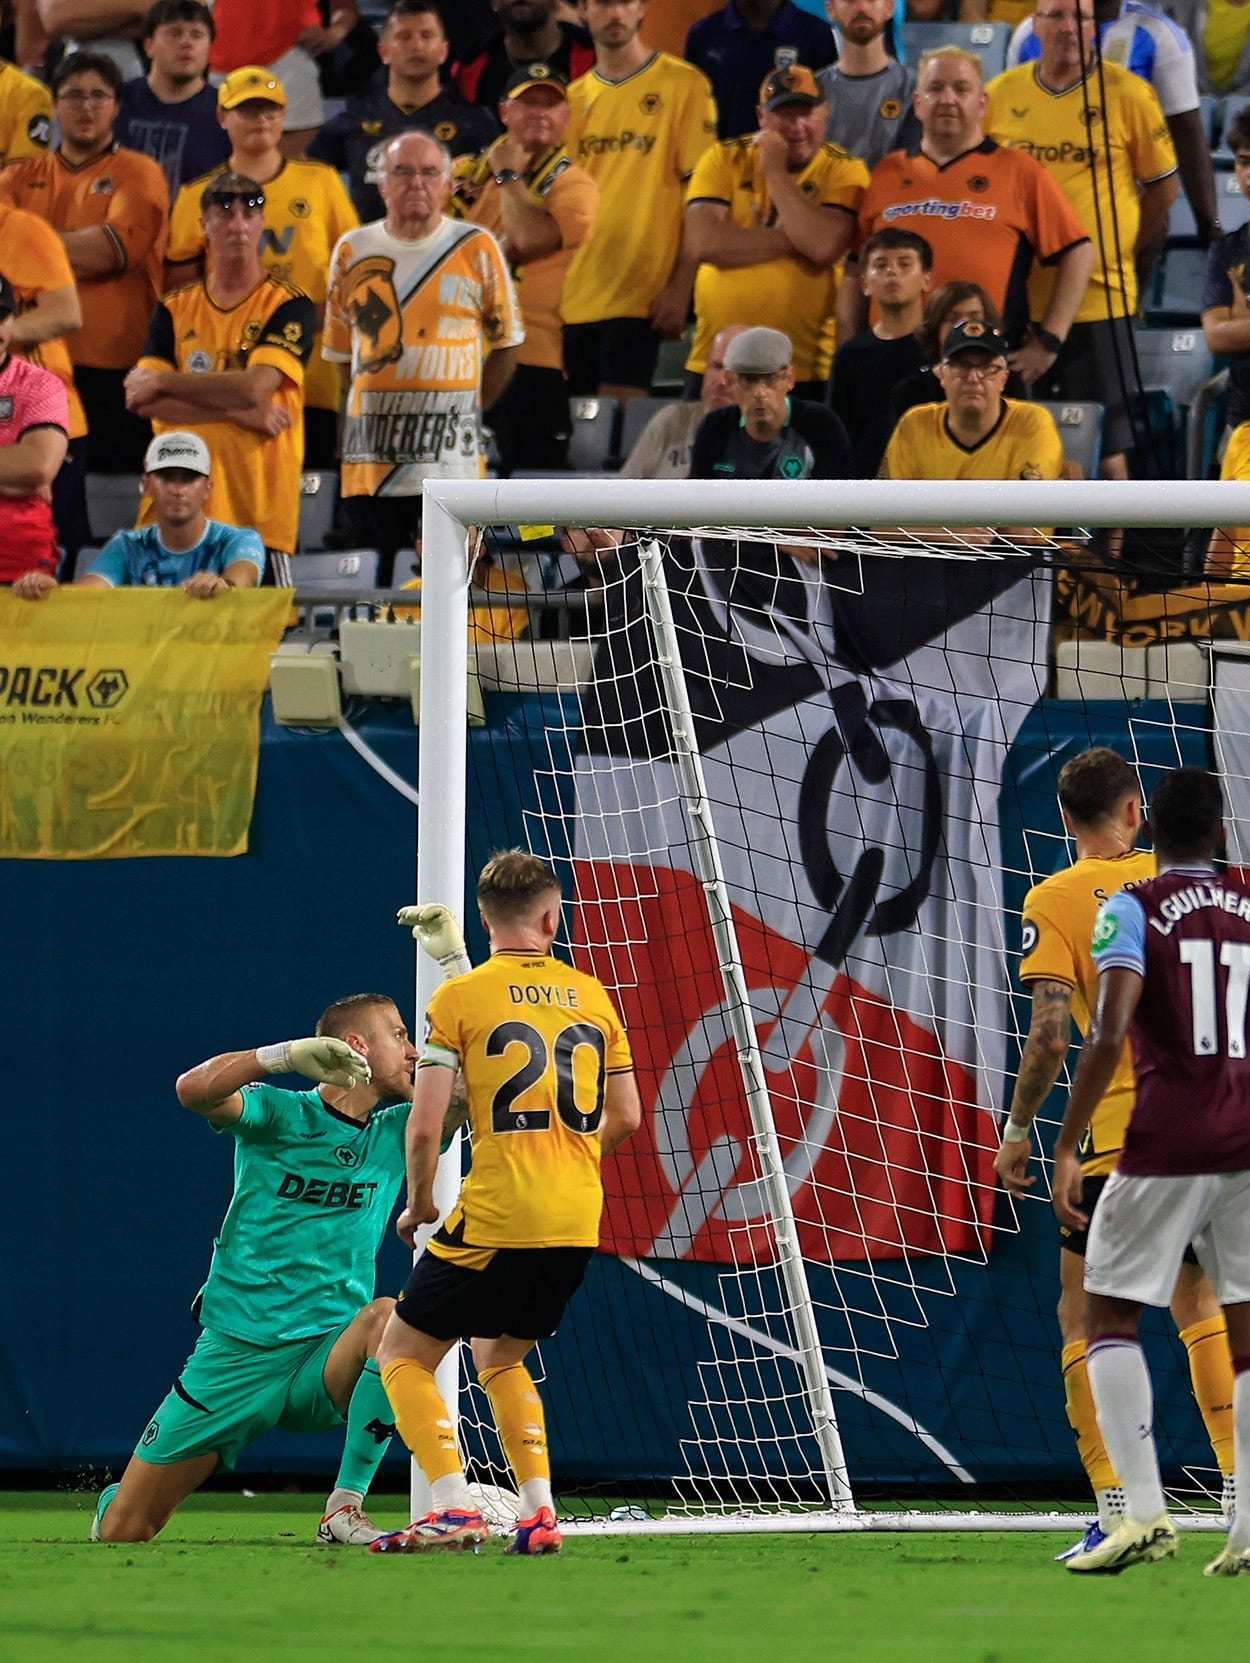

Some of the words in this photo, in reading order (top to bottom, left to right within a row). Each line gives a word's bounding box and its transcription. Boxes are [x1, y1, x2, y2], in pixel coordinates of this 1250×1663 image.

[882, 198, 997, 221] sportingbet
[395, 344, 475, 381] WOLVES
[22, 711, 101, 726] Wanderers
[508, 984, 580, 1009] DOYLE
[485, 1020, 607, 1136] 20
[276, 1172, 379, 1209] DEBET
